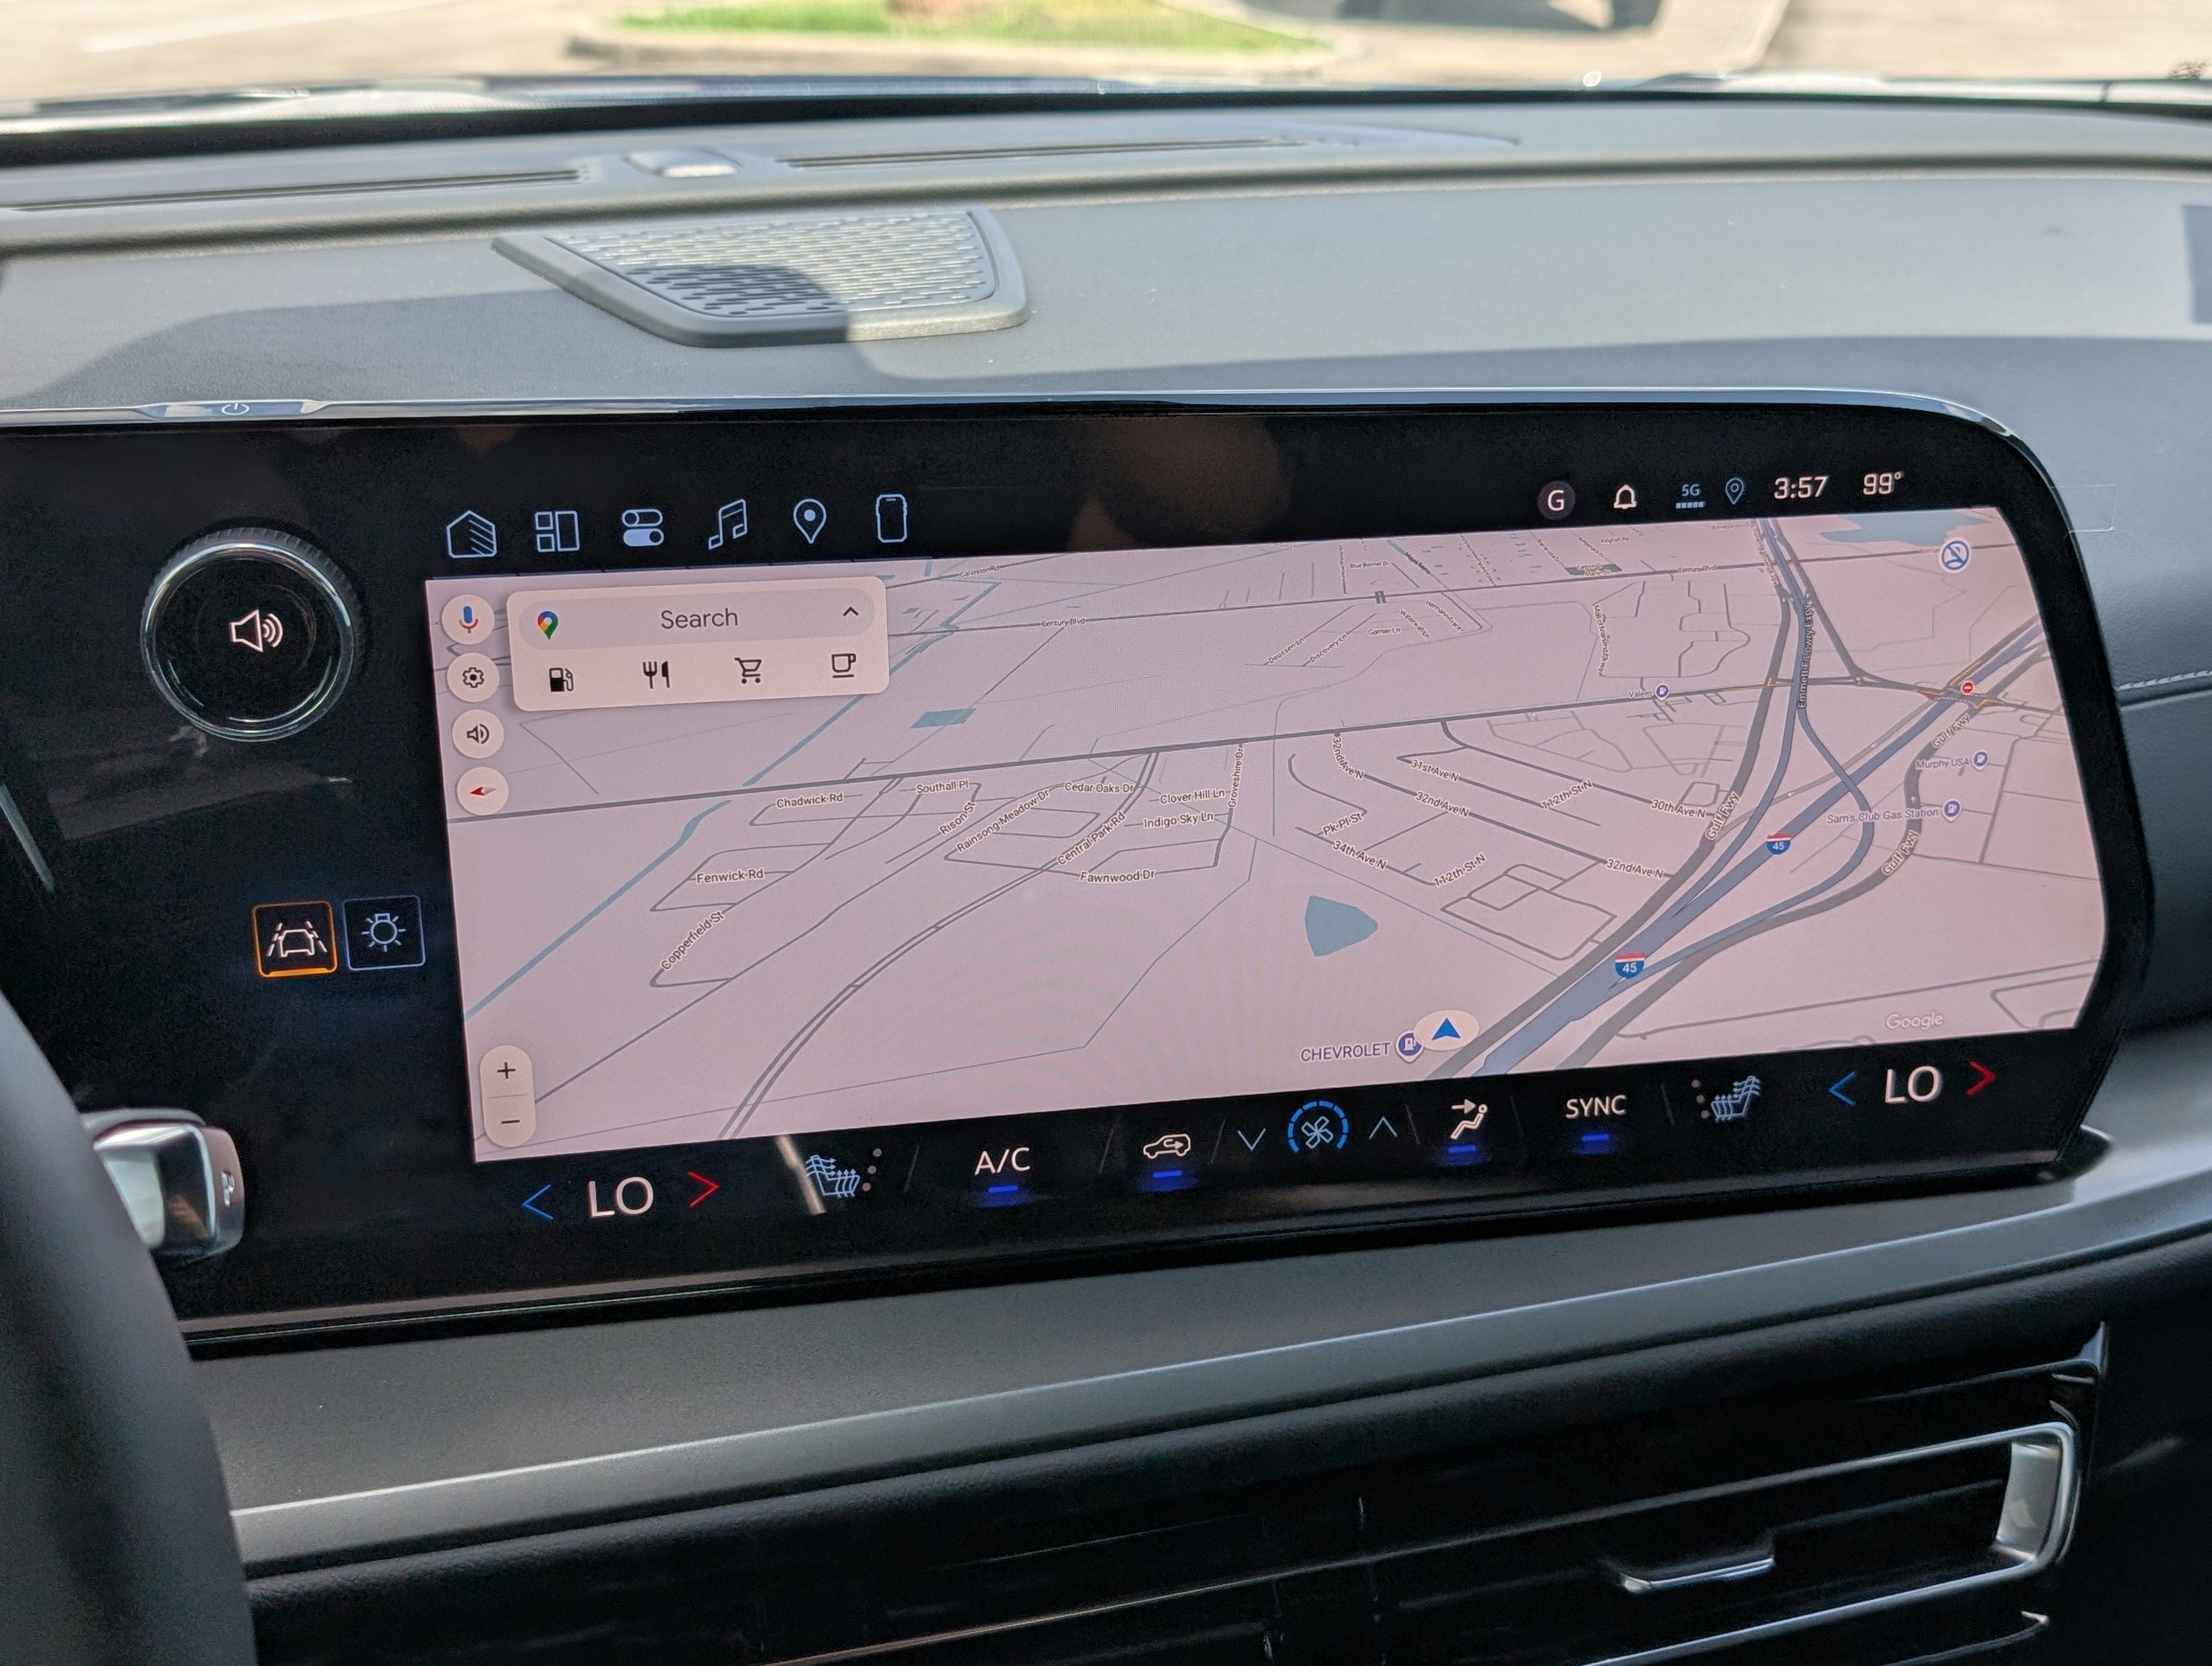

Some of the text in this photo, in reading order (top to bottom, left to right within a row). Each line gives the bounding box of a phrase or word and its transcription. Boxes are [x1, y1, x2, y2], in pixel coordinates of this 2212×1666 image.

[1681, 484, 1700, 496] 5G
[1774, 476, 1828, 499] 3:57
[1863, 471, 1904, 495] 99°
[1547, 490, 1565, 511] G
[661, 608, 738, 629] Search
[1295, 637, 1304, 647] Ln
[1309, 633, 1348, 663] Discovery Ln
[1629, 690, 1652, 699] Valero
[1932, 714, 1970, 748] Gulf Fwy
[1333, 738, 1364, 779] 32nd Ave N
[1916, 757, 1969, 771] Murphy USA
[1228, 747, 1244, 808] Groveshire Dr
[1411, 760, 1459, 782] 31st Ave N
[916, 780, 968, 794] Southall Pl
[1064, 782, 1134, 793] Cedar Oaks Dr
[1160, 789, 1225, 804] Clover Hill Ln
[1542, 779, 1593, 810] 112th St N
[776, 792, 843, 808] Chadwick Rd
[1416, 792, 1469, 817] 32nd Ave N
[1651, 799, 1706, 819] 30th Ave N
[939, 802, 976, 835] Rison St
[957, 790, 1050, 852] Rainsong Meadow Dr
[1144, 812, 1213, 828] Indigo Sky Ln
[1322, 812, 1362, 836] Pk Pl St
[1706, 793, 1739, 840] Gulf Fwy
[1827, 808, 1938, 824] Sam's Club Gas Station
[1058, 812, 1126, 865] Central Park Rd
[1773, 841, 1784, 851] 45
[1333, 841, 1387, 870] 34th Ave N
[1882, 830, 1918, 875] Gulf Fwy
[697, 869, 764, 883] Fenwick Rd
[1080, 870, 1156, 883] Fawnwood Dr
[1433, 853, 1486, 886] 112th St N
[1606, 858, 1664, 879] 32nd Ave N
[661, 911, 725, 970] Copperfield St
[1622, 962, 1637, 973] 45
[1886, 1010, 1944, 1030] Google
[1301, 1042, 1391, 1062] CHEVROLET
[1885, 1066, 1943, 1104] LO
[1566, 1095, 1626, 1119] SYNC
[974, 1146, 1030, 1175] A/C
[587, 1176, 654, 1219] LO
